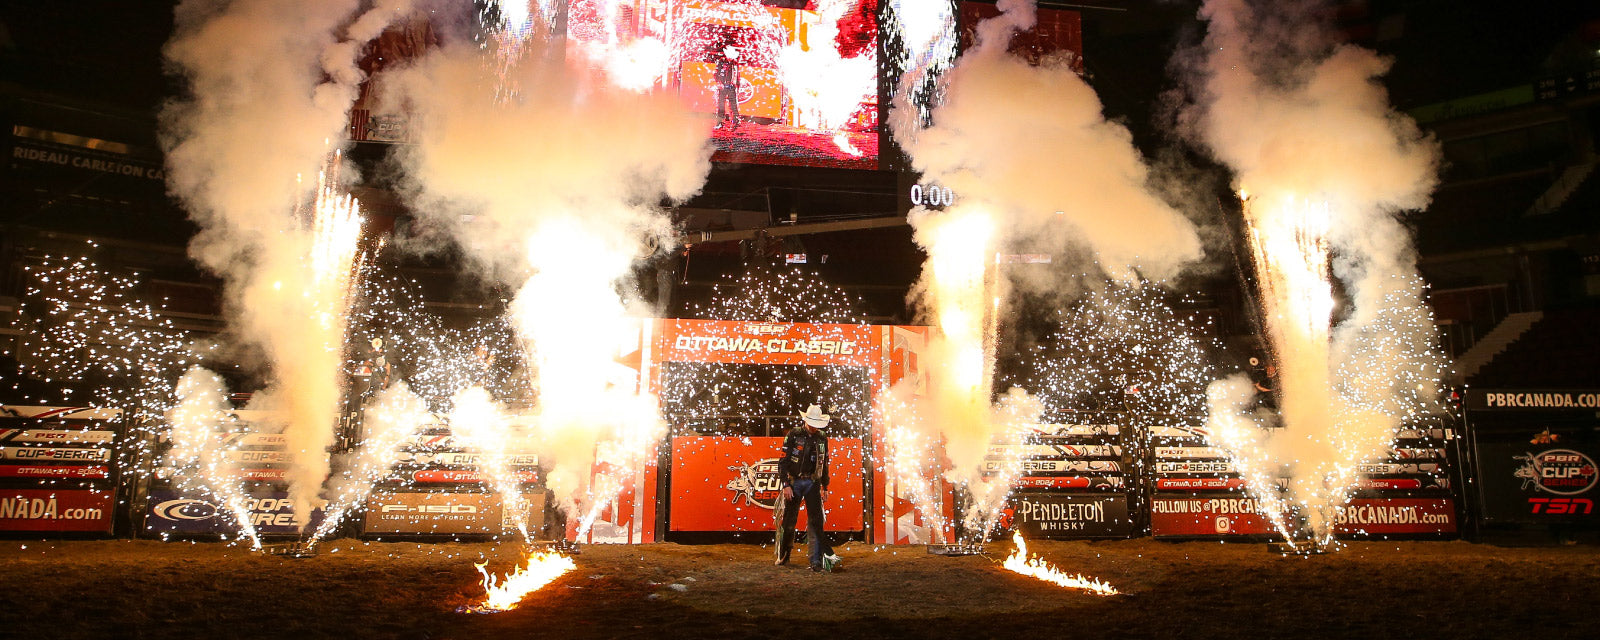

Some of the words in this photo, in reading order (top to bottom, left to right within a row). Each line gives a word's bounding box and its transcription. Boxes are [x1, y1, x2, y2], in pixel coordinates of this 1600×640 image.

[13, 146, 68, 165] RIDEAU
[910, 184, 954, 207] 0.00
[675, 335, 761, 353] OTTAWA
[766, 339, 857, 355] CLASSIC
[16, 449, 46, 458] CUP
[1160, 463, 1183, 472] CUP
[1188, 463, 1228, 472] SERIES
[1542, 466, 1581, 478] CUP
[1543, 478, 1588, 486] SERIES
[1020, 500, 1105, 523] PENDLETON
[1153, 500, 1189, 513] FOLLOW
[1189, 500, 1202, 513] US
[1528, 497, 1594, 514] TSN
[1040, 522, 1086, 531] WHISKY
